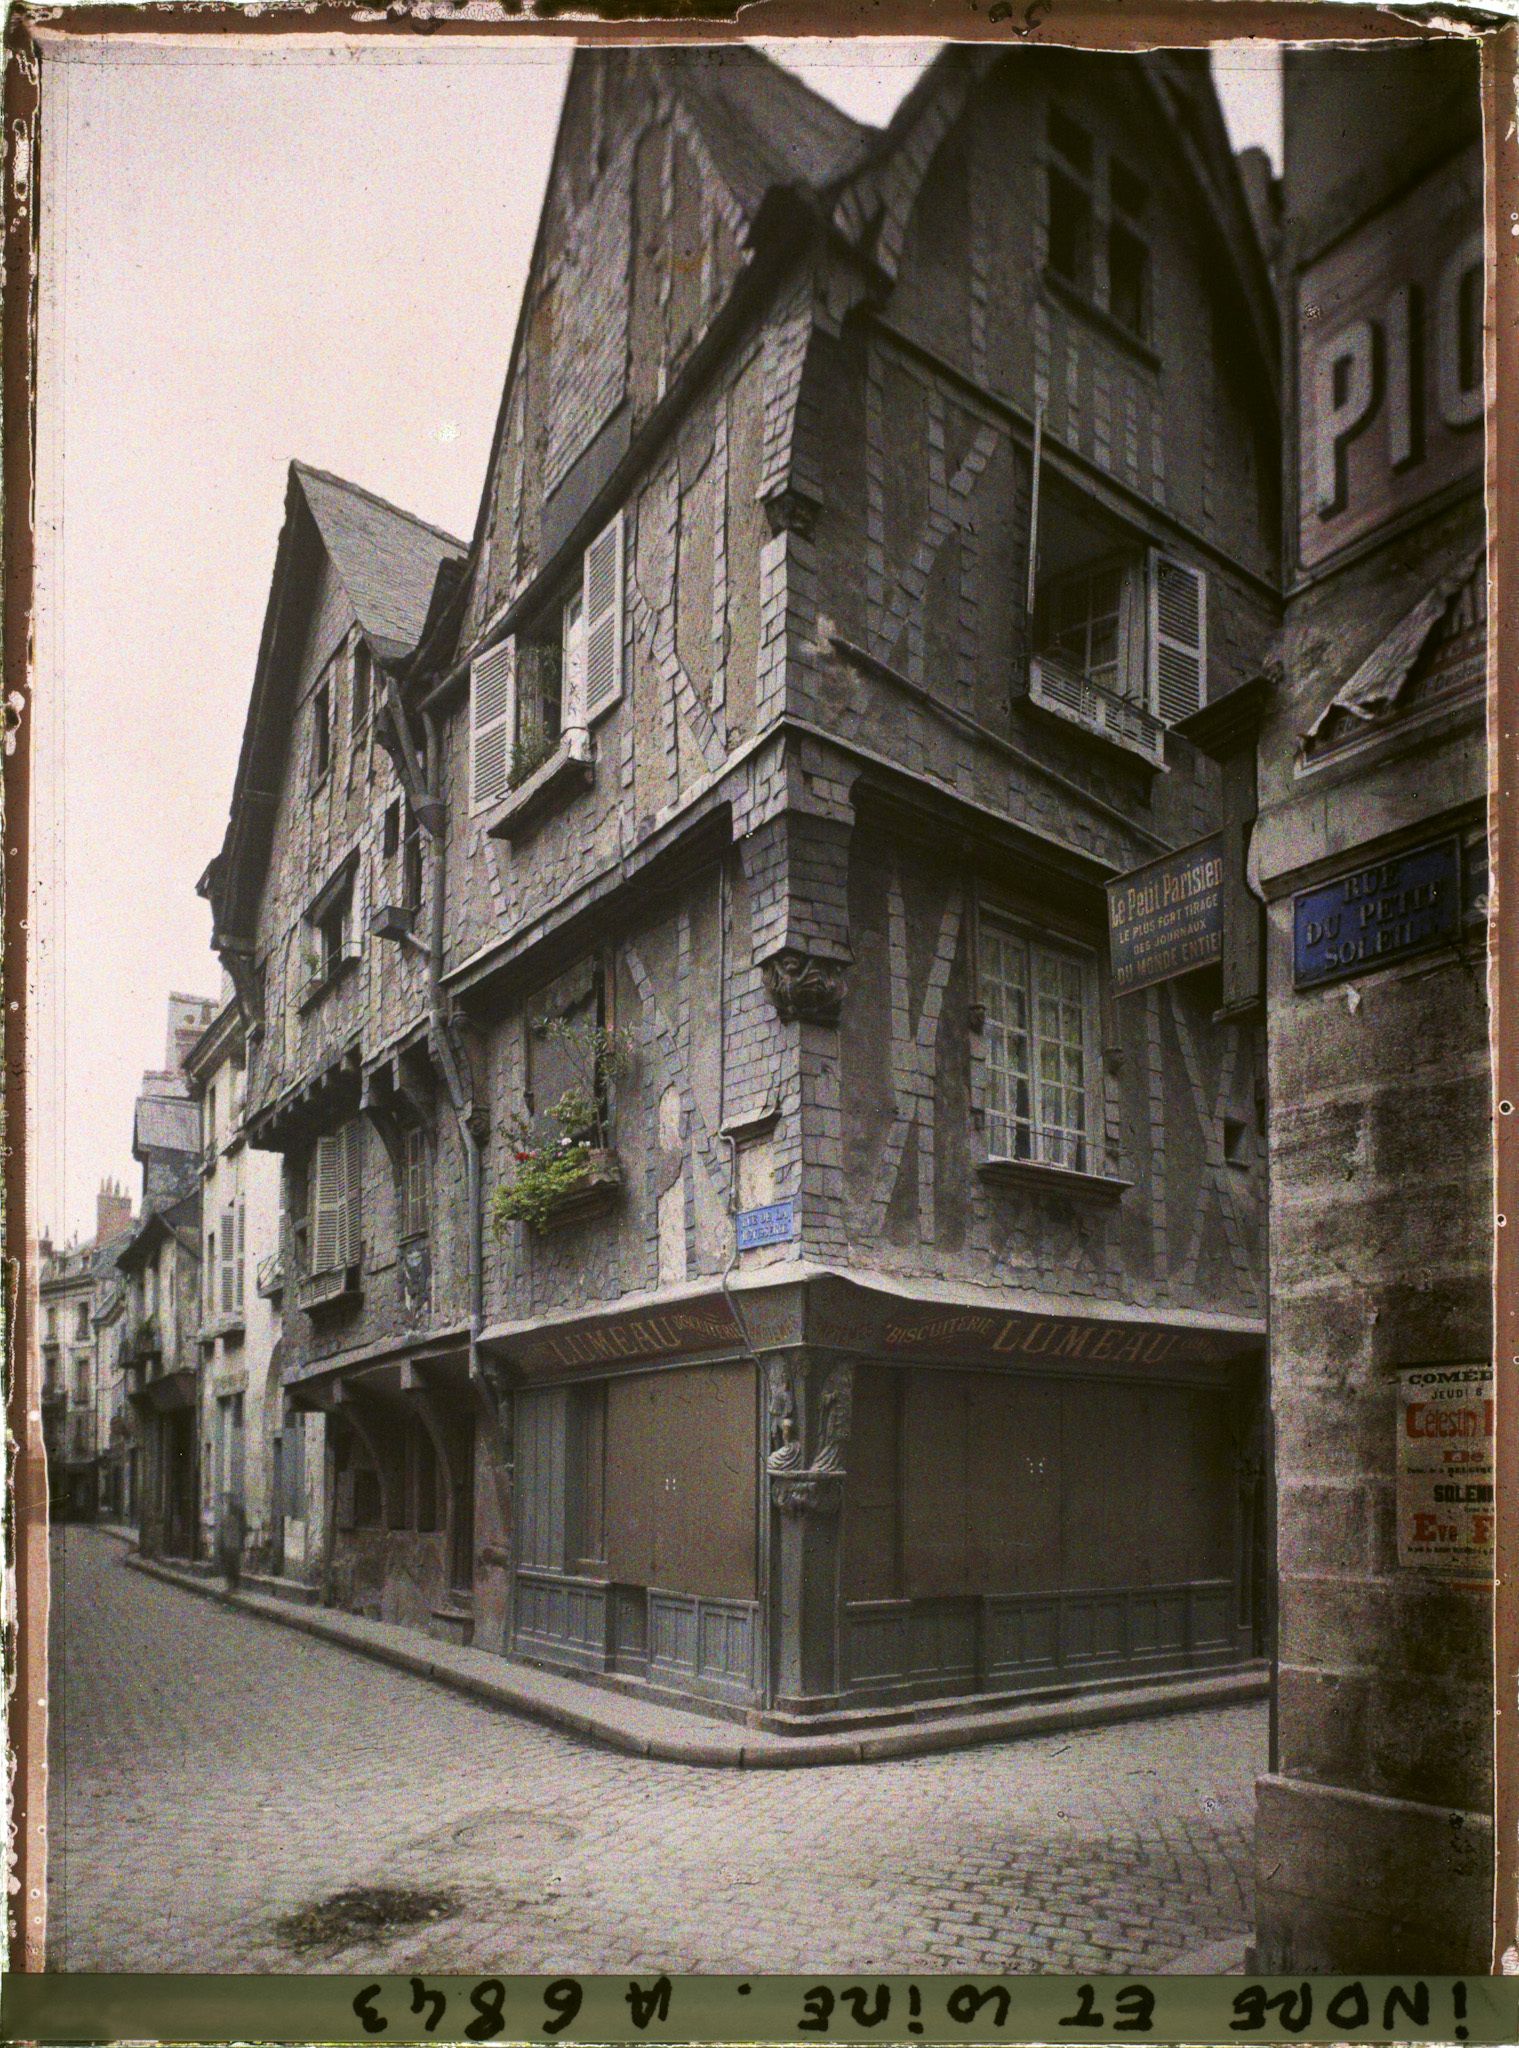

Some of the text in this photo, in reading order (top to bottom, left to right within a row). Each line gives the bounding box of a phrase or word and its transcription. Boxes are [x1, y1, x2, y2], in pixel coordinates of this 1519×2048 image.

[1111, 858, 1222, 929] Le Petit Parisien
[1345, 866, 1400, 903] RUE
[1120, 893, 1218, 944] LE PLUS FORT TIRAGE
[1134, 919, 1207, 956] DES JOURNAUX
[1306, 880, 1439, 947] DU PETIT
[1117, 963, 1133, 986] DU
[1137, 948, 1177, 976] MONDE
[1325, 920, 1415, 971] SOLEIL
[550, 1317, 683, 1366] LUMEAU
[885, 1315, 996, 1344] BISCUITERIE
[993, 1319, 1184, 1364] LUMEAU
[1431, 1388, 1468, 1400] JEUDI
